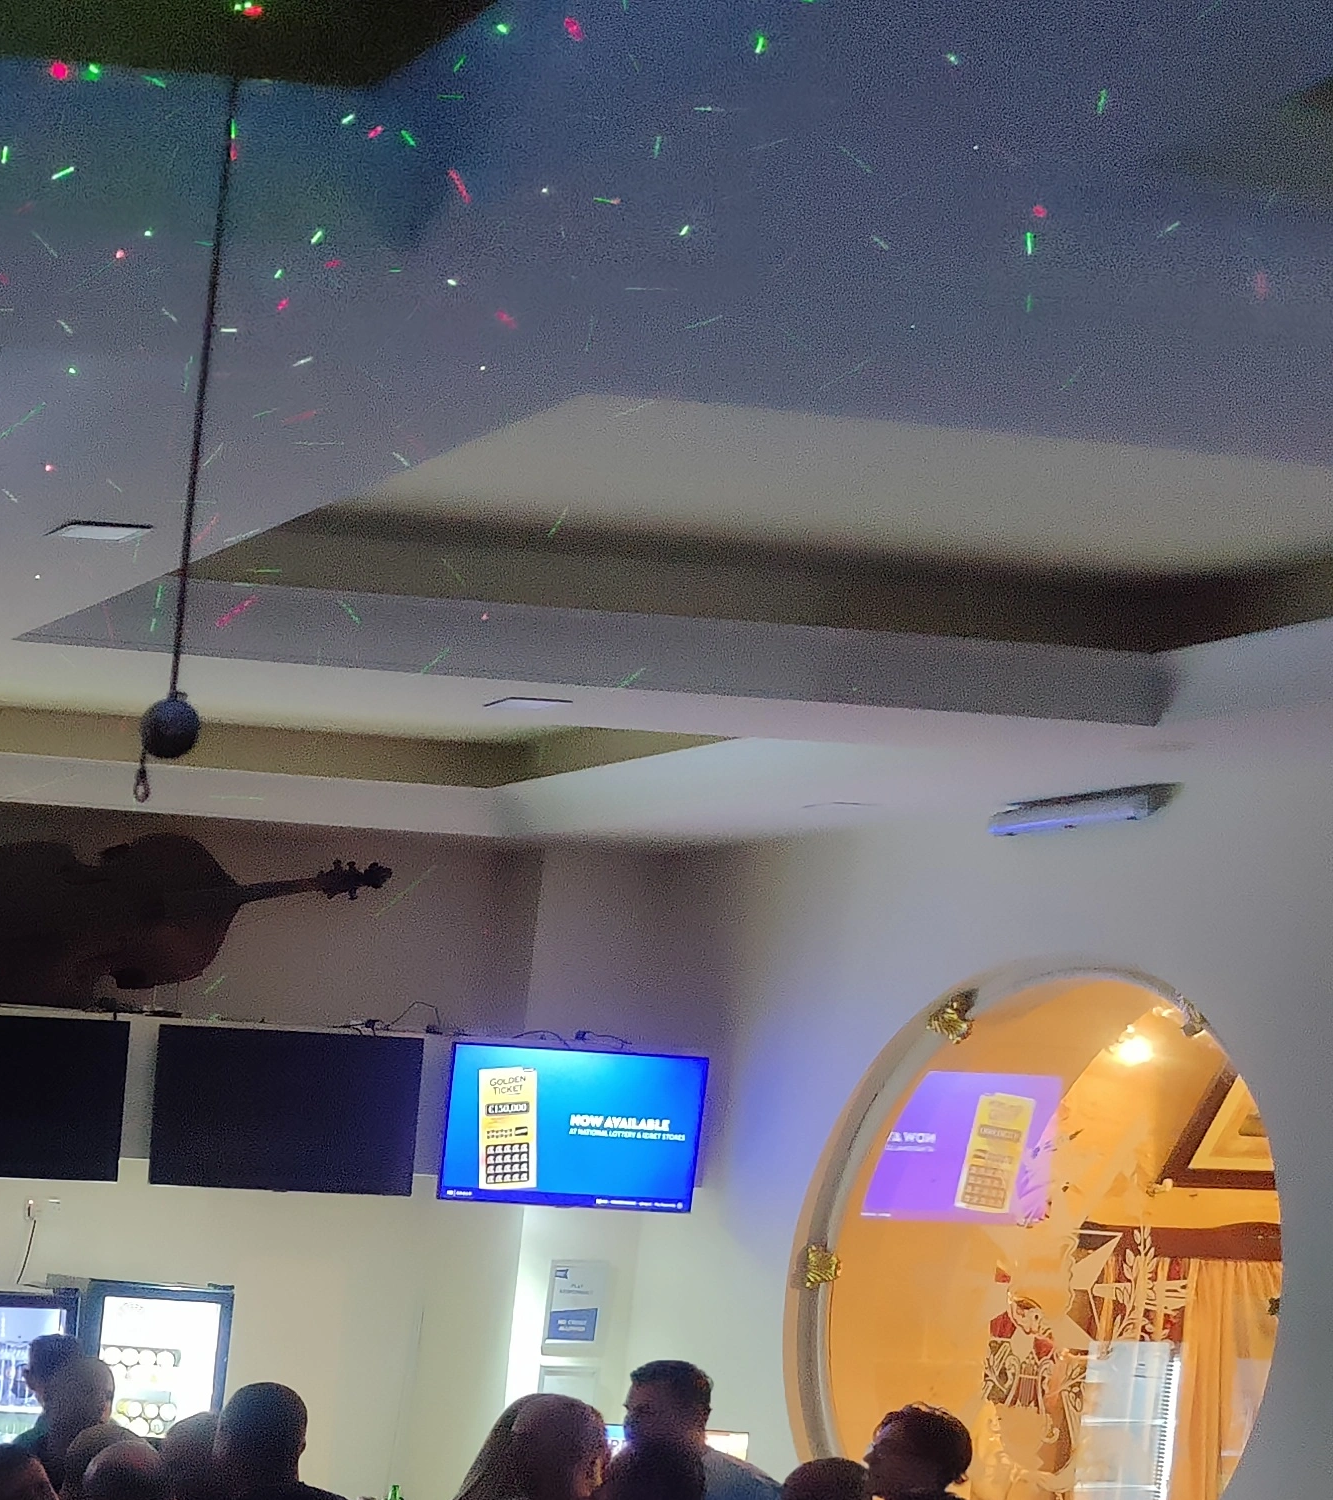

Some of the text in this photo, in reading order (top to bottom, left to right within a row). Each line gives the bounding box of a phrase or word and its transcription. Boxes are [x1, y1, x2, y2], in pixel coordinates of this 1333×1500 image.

[489, 1075, 526, 1086] GOLDEN
[493, 1085, 523, 1095] TICKET
[569, 1114, 670, 1131] NOW AVAILABLE
